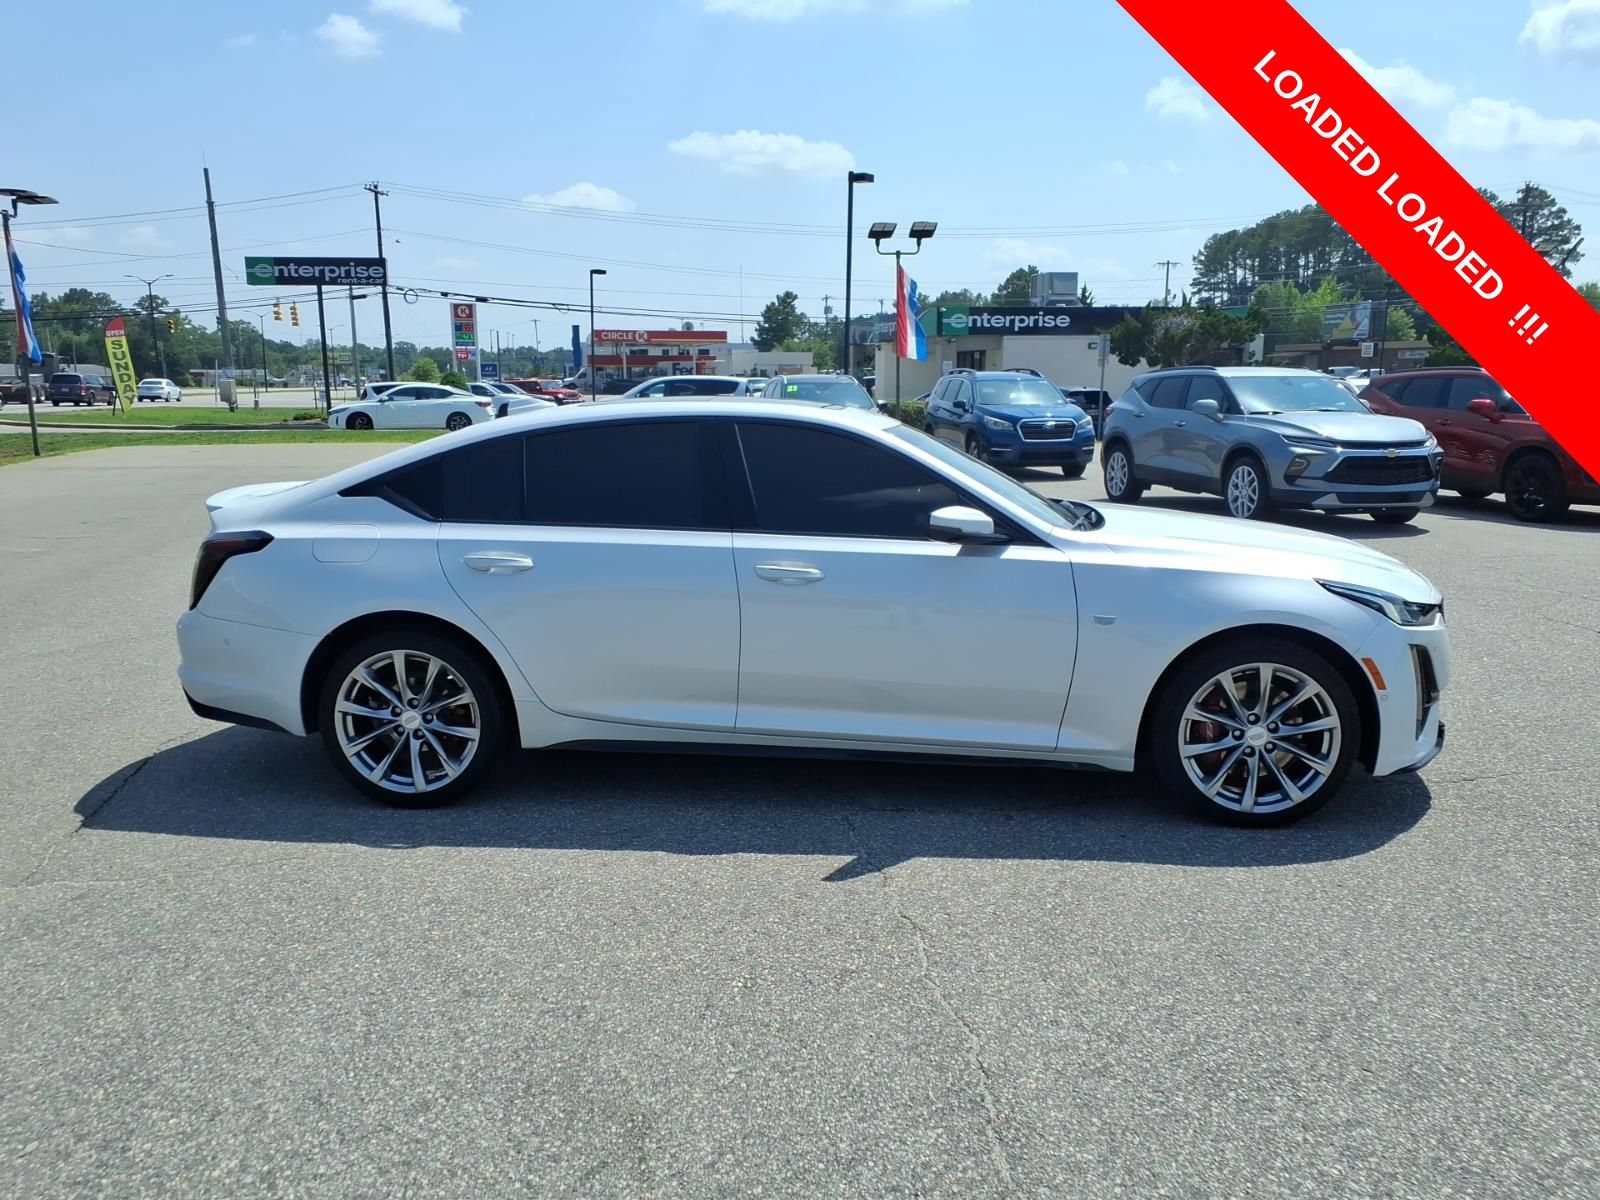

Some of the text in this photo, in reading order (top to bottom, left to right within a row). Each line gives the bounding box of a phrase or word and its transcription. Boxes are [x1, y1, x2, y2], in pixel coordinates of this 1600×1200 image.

[253, 262, 385, 281] enterprise
[949, 311, 1071, 331] enterprise
[105, 329, 125, 337] OPEN
[601, 331, 634, 340] CIRCLE
[110, 339, 137, 405] SUNDAY
